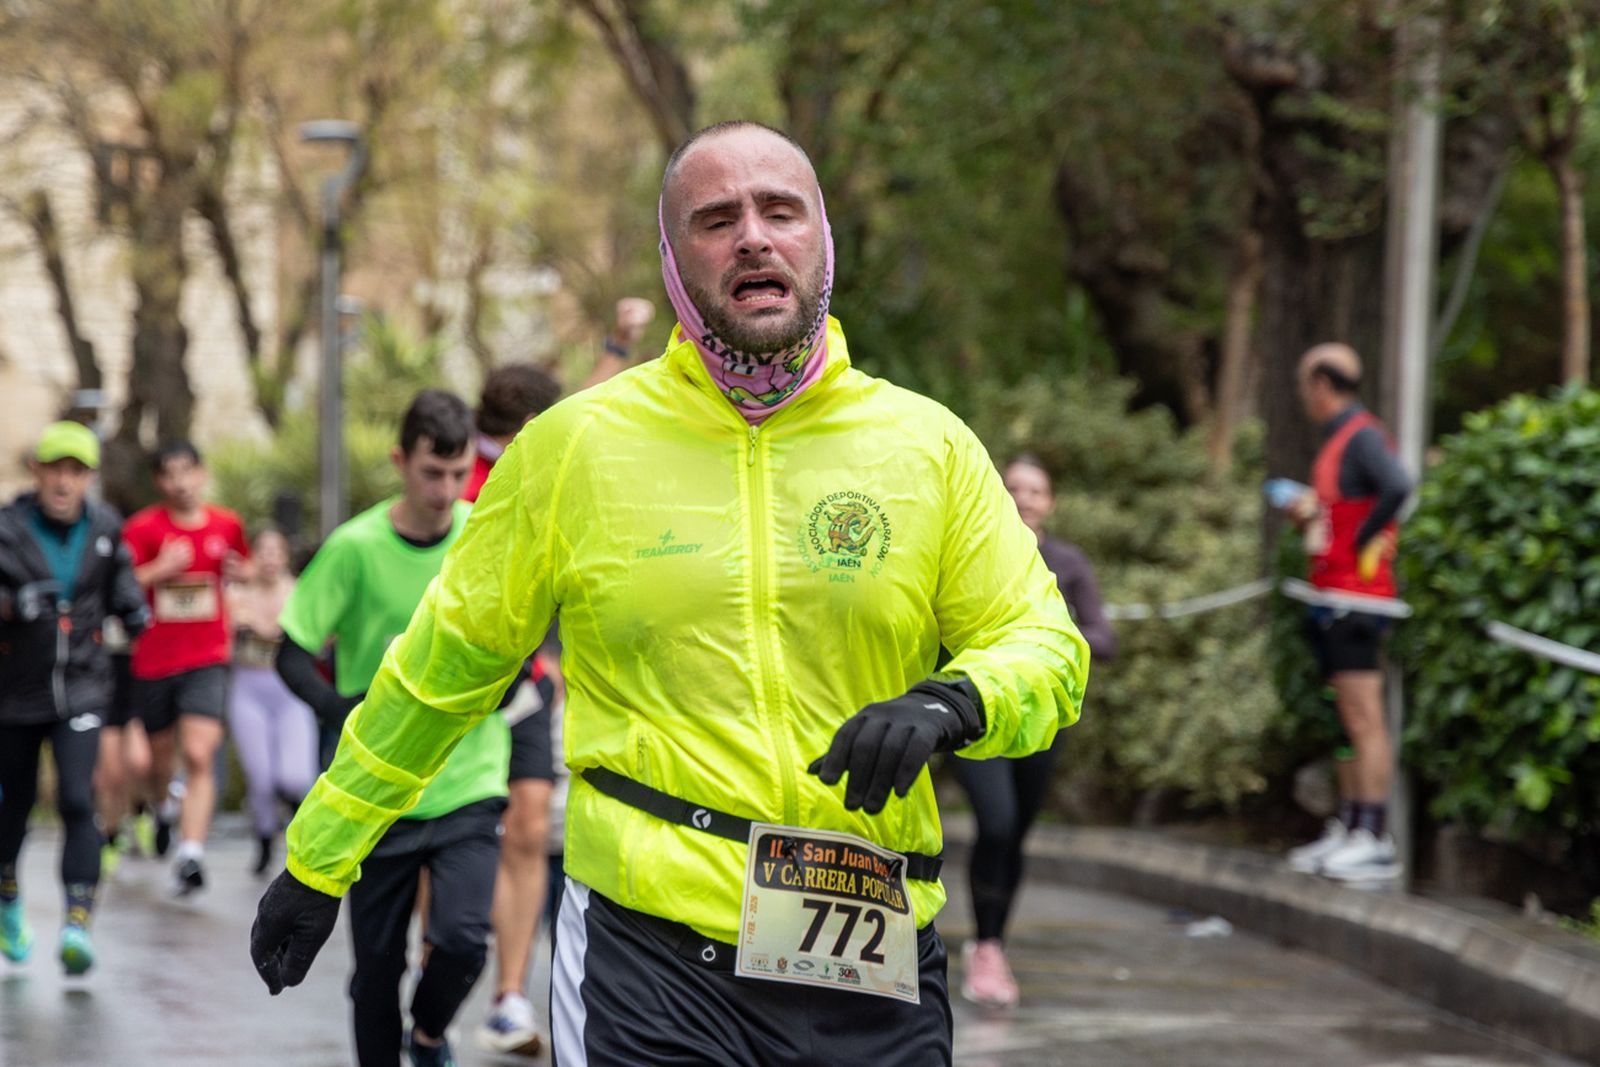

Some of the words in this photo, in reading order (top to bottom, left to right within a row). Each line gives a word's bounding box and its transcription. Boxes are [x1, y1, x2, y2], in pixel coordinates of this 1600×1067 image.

[827, 491, 880, 513] DEPORTIVA
[803, 842, 837, 863] San
[840, 847, 872, 871] Juan
[763, 862, 776, 882] V
[781, 864, 857, 894] CARRERA
[798, 898, 886, 965] 772
